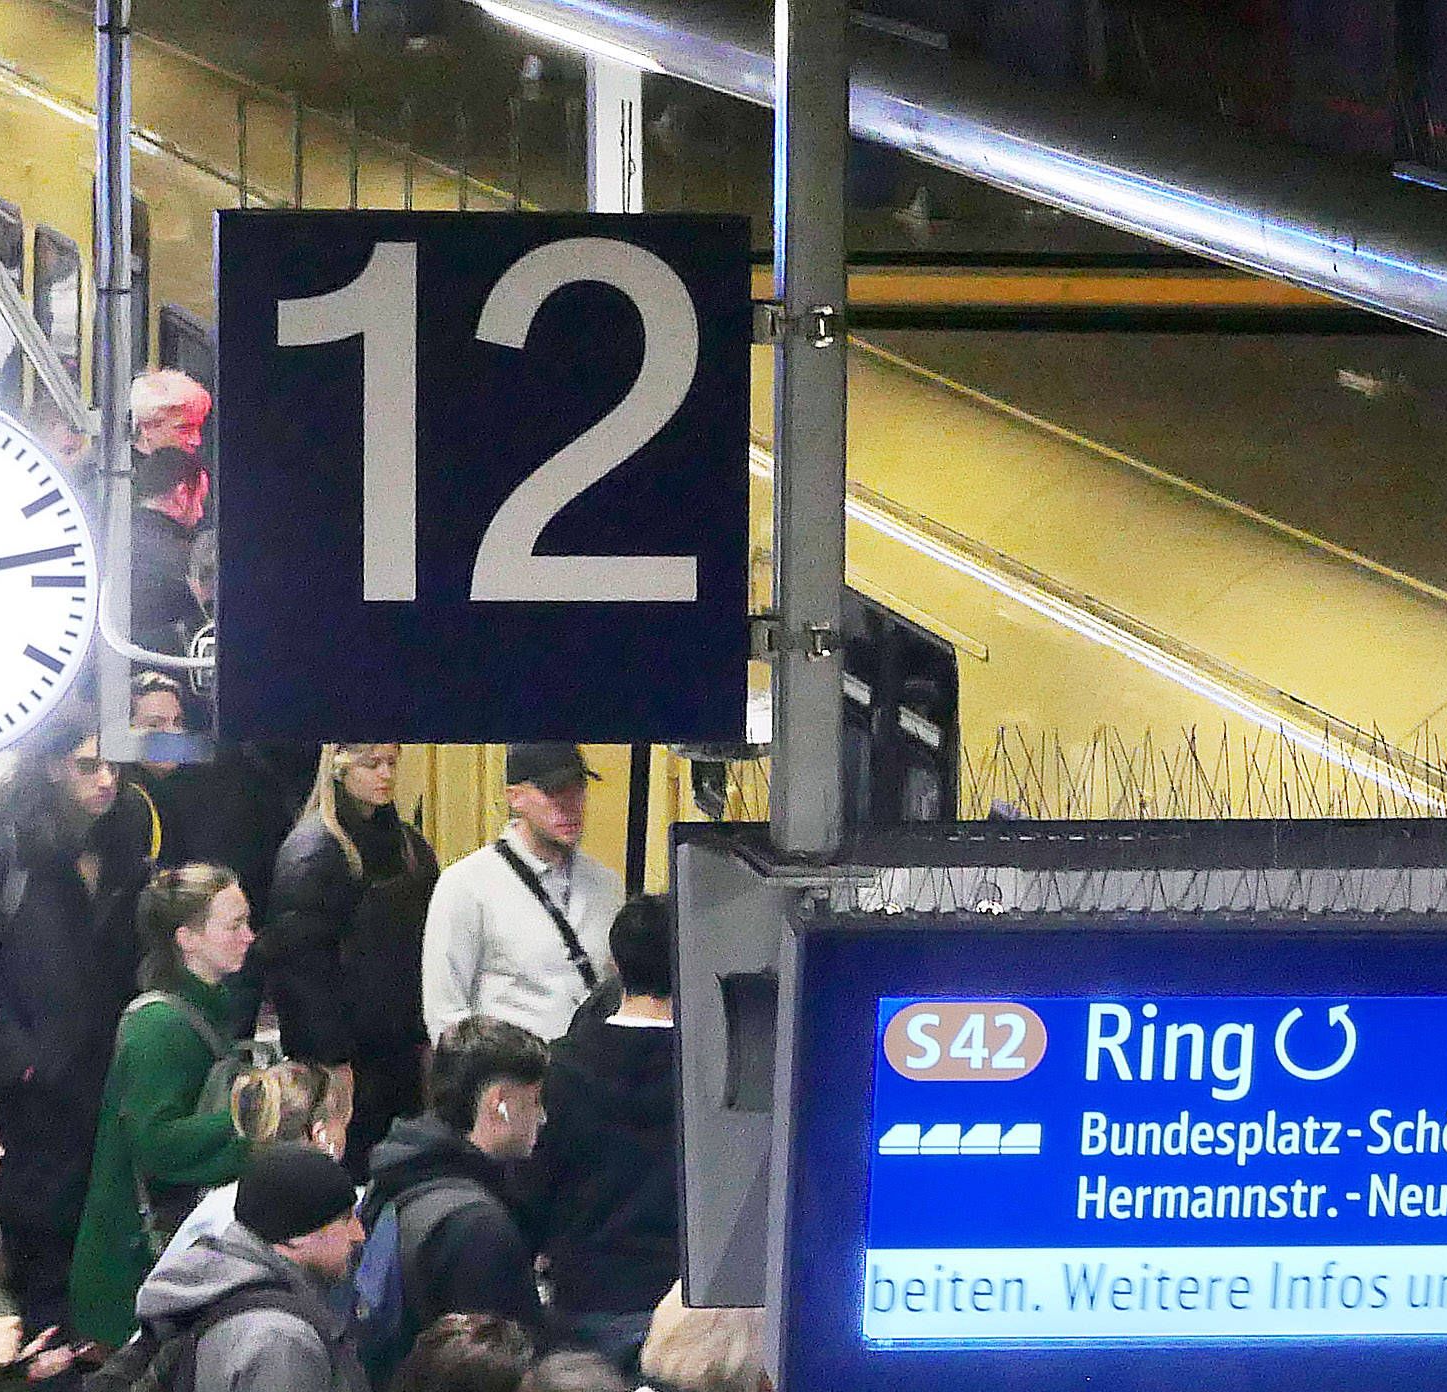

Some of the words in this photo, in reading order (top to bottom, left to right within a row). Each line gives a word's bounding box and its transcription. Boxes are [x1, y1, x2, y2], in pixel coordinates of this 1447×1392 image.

[276, 236, 700, 602] 12
[1084, 1002, 1254, 1101] Ring
[871, 1264, 1043, 1313] beiten.
[1063, 1261, 1252, 1312] Weitere
[1270, 1260, 1389, 1310] Infos
